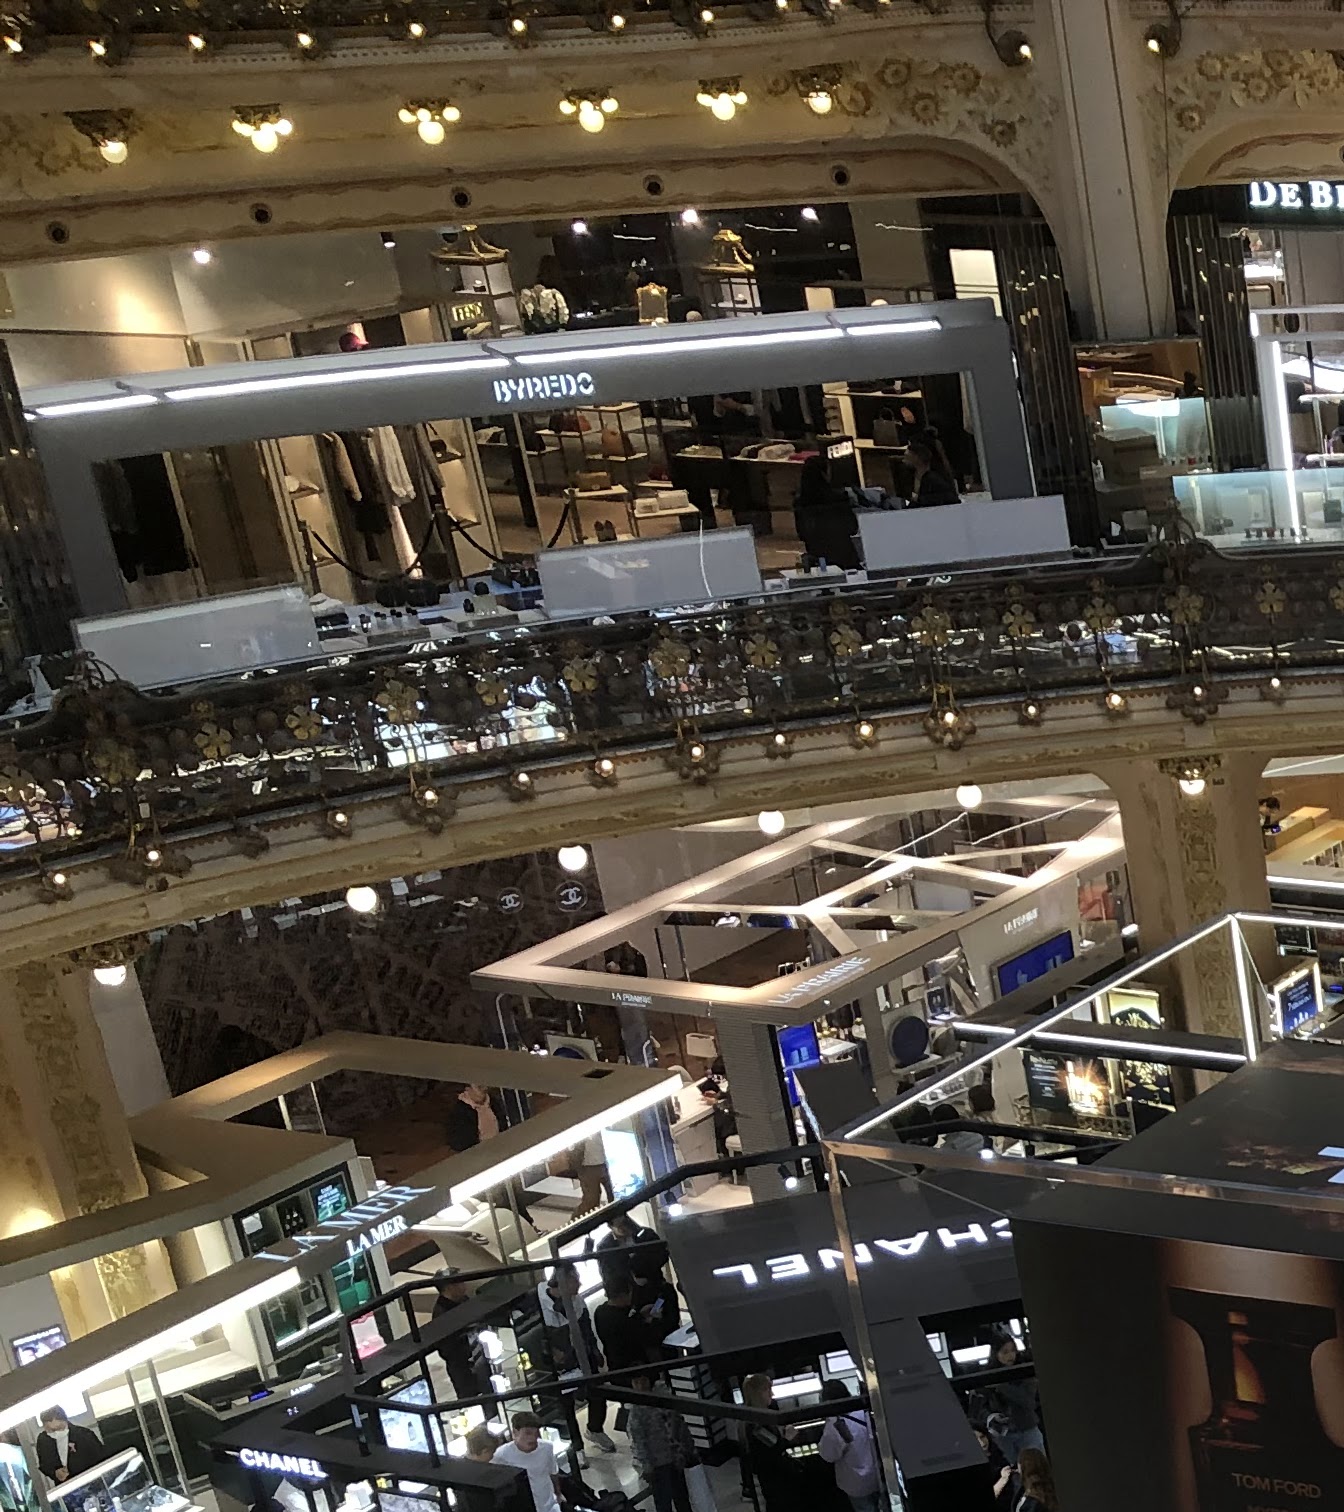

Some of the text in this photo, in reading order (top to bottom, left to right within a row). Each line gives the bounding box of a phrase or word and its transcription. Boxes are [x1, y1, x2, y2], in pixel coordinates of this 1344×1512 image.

[1250, 181, 1301, 208] DE
[493, 372, 595, 403] BYREDO
[253, 1233, 340, 1263] LA
[316, 1185, 436, 1231] MER
[345, 1214, 408, 1257] LA MER
[240, 1448, 330, 1479] CHANEL
[1231, 1472, 1322, 1499] TOM FORD
